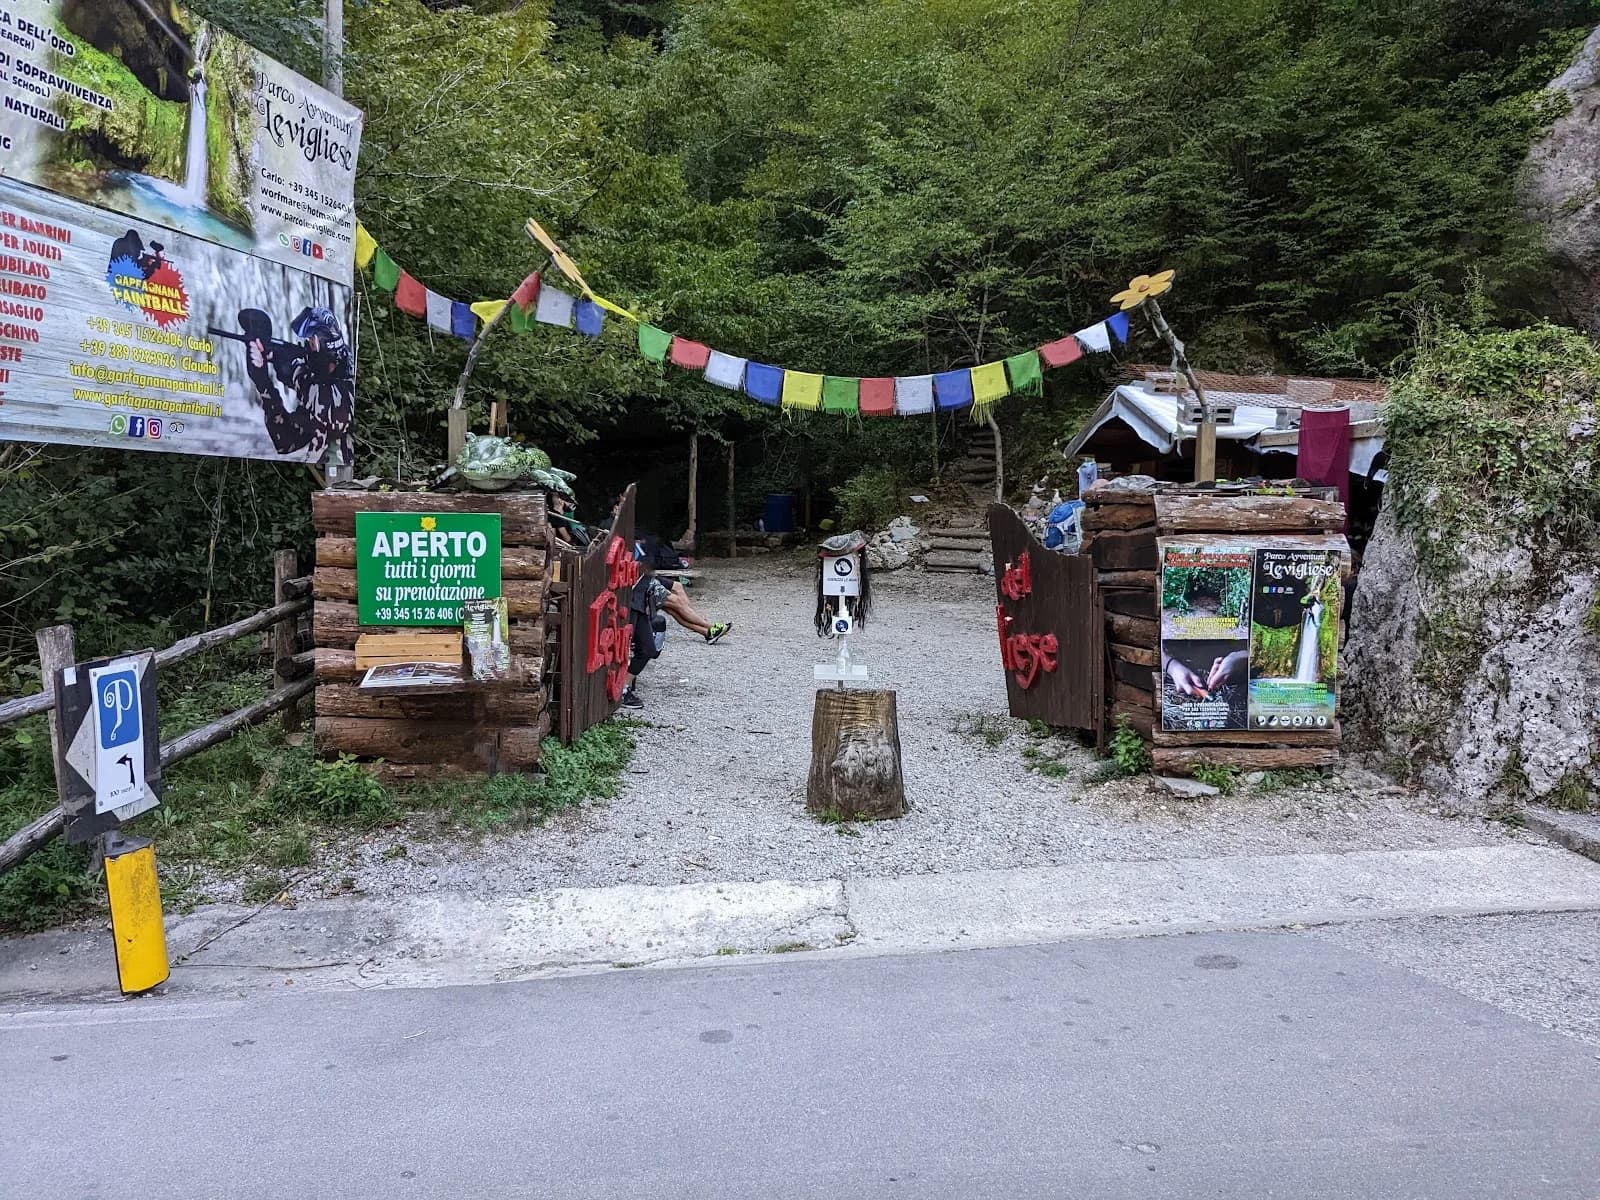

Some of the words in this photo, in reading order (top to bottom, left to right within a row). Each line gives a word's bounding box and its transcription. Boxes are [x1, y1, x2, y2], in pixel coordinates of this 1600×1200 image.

[1, 29, 35, 51] EARCH)
[18, 19, 74, 56] DELL'ORO
[0, 52, 10, 67] DI
[16, 60, 113, 111] SOPRAVVIVENZA
[12, 77, 51, 98] SCHOOL)
[257, 71, 295, 105] Parco
[5, 96, 65, 129] NATURALI
[256, 95, 352, 171] Levigliese
[261, 168, 285, 186] Carlo:
[288, 181, 303, 194] +39
[305, 187, 318, 201] 345
[261, 186, 351, 230] worfmare@hotmailom
[0, 210, 16, 228] ER
[20, 215, 72, 244] BAMBINI
[23, 238, 62, 261] ADULTI
[0, 279, 46, 301] LIBATO
[112, 287, 188, 317] PAINTBALL
[87, 316, 110, 334] +39
[112, 320, 132, 339] 345
[136, 325, 182, 349] 1526406
[184, 335, 214, 356] (Carlo)
[80, 339, 106, 357] +39
[108, 342, 130, 361] 389
[132, 346, 177, 369] 8283926
[69, 360, 225, 398] info@garfagnanapaintball.it
[73, 388, 222, 417] www.garfagnanapaintball.it
[371, 531, 487, 558] APERTO
[1263, 551, 1286, 561] Parco
[385, 558, 418, 580] tutti
[421, 558, 427, 579] i
[429, 558, 477, 584] giorni
[1262, 560, 1334, 580] Levigliese
[375, 586, 393, 601] su
[394, 580, 485, 606] prenotazione
[375, 607, 392, 620] +39
[394, 607, 411, 620] 345
[413, 607, 424, 620] 15
[424, 607, 436, 620] 26
[437, 607, 454, 620] 406
[103, 678, 133, 742] P
